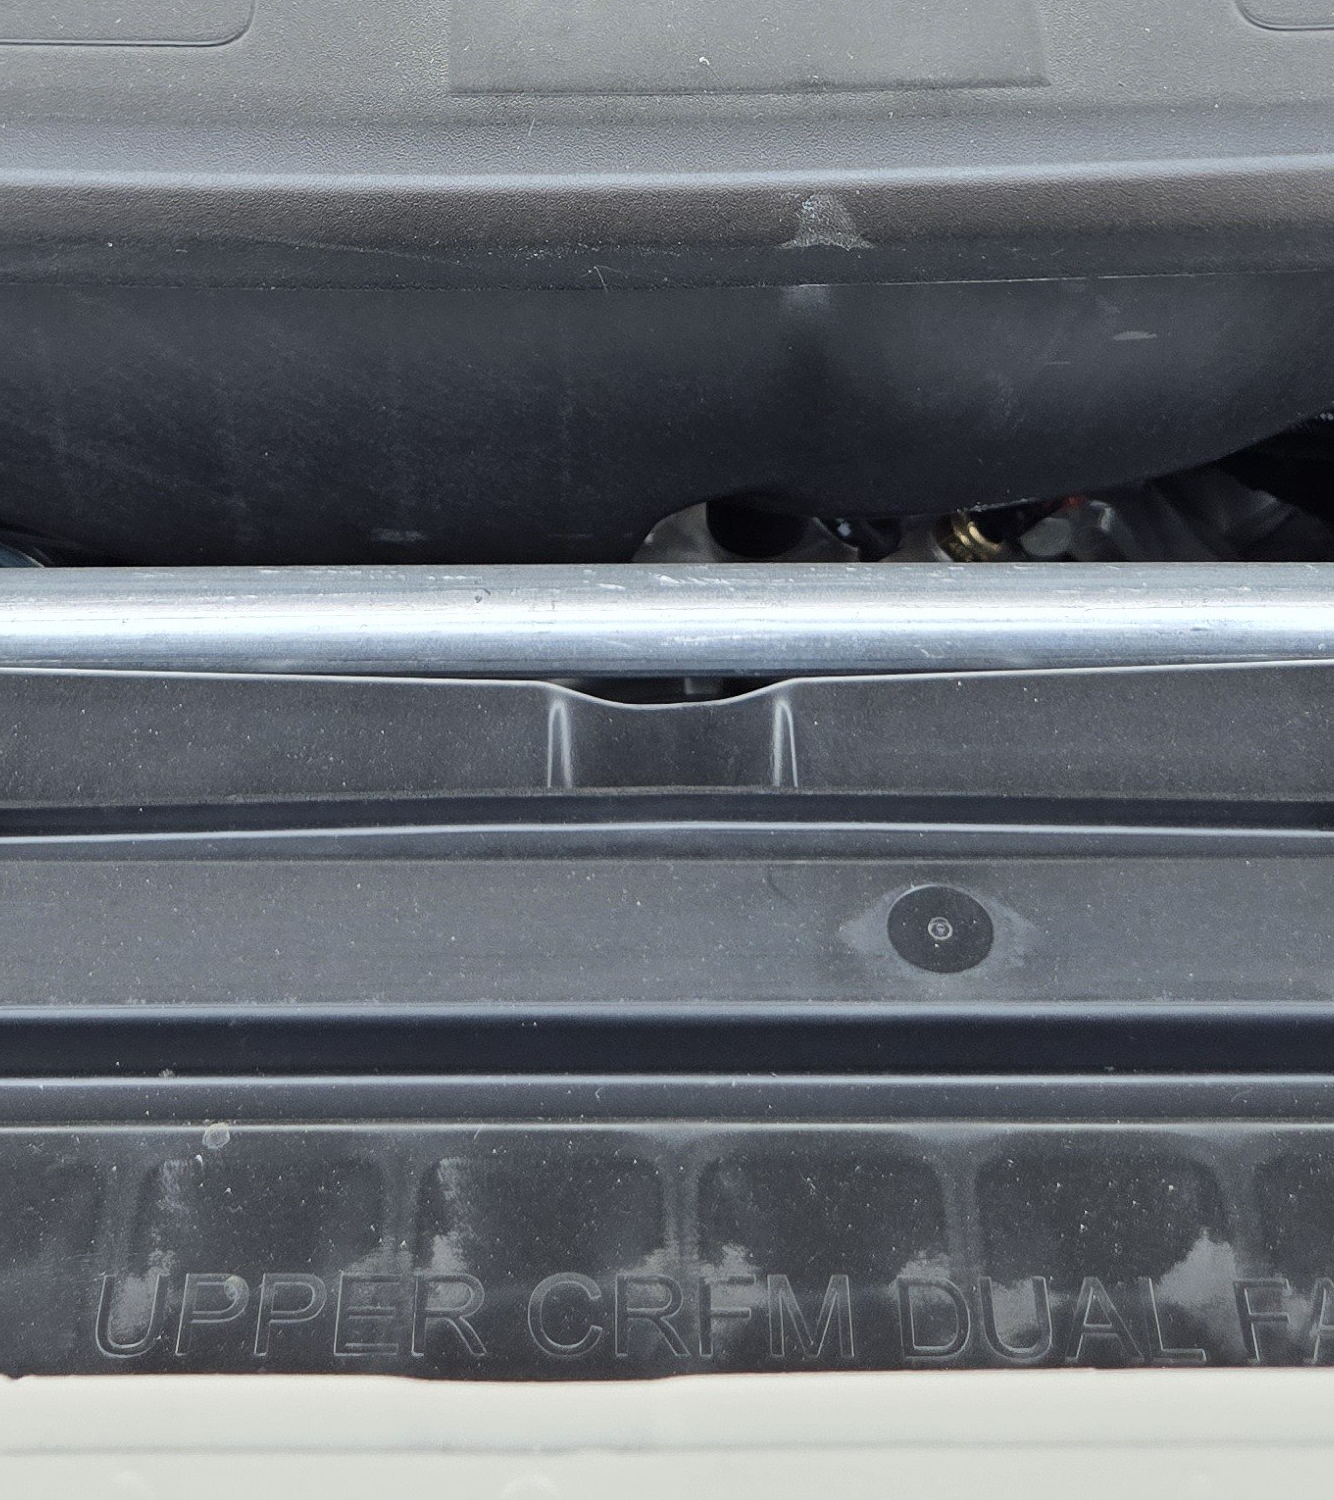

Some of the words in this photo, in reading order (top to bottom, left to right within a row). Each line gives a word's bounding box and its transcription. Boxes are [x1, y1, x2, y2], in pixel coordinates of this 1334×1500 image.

[93, 1271, 487, 1359] UPPER
[526, 1272, 859, 1360] CRFM
[897, 1274, 1207, 1364] DUAL
